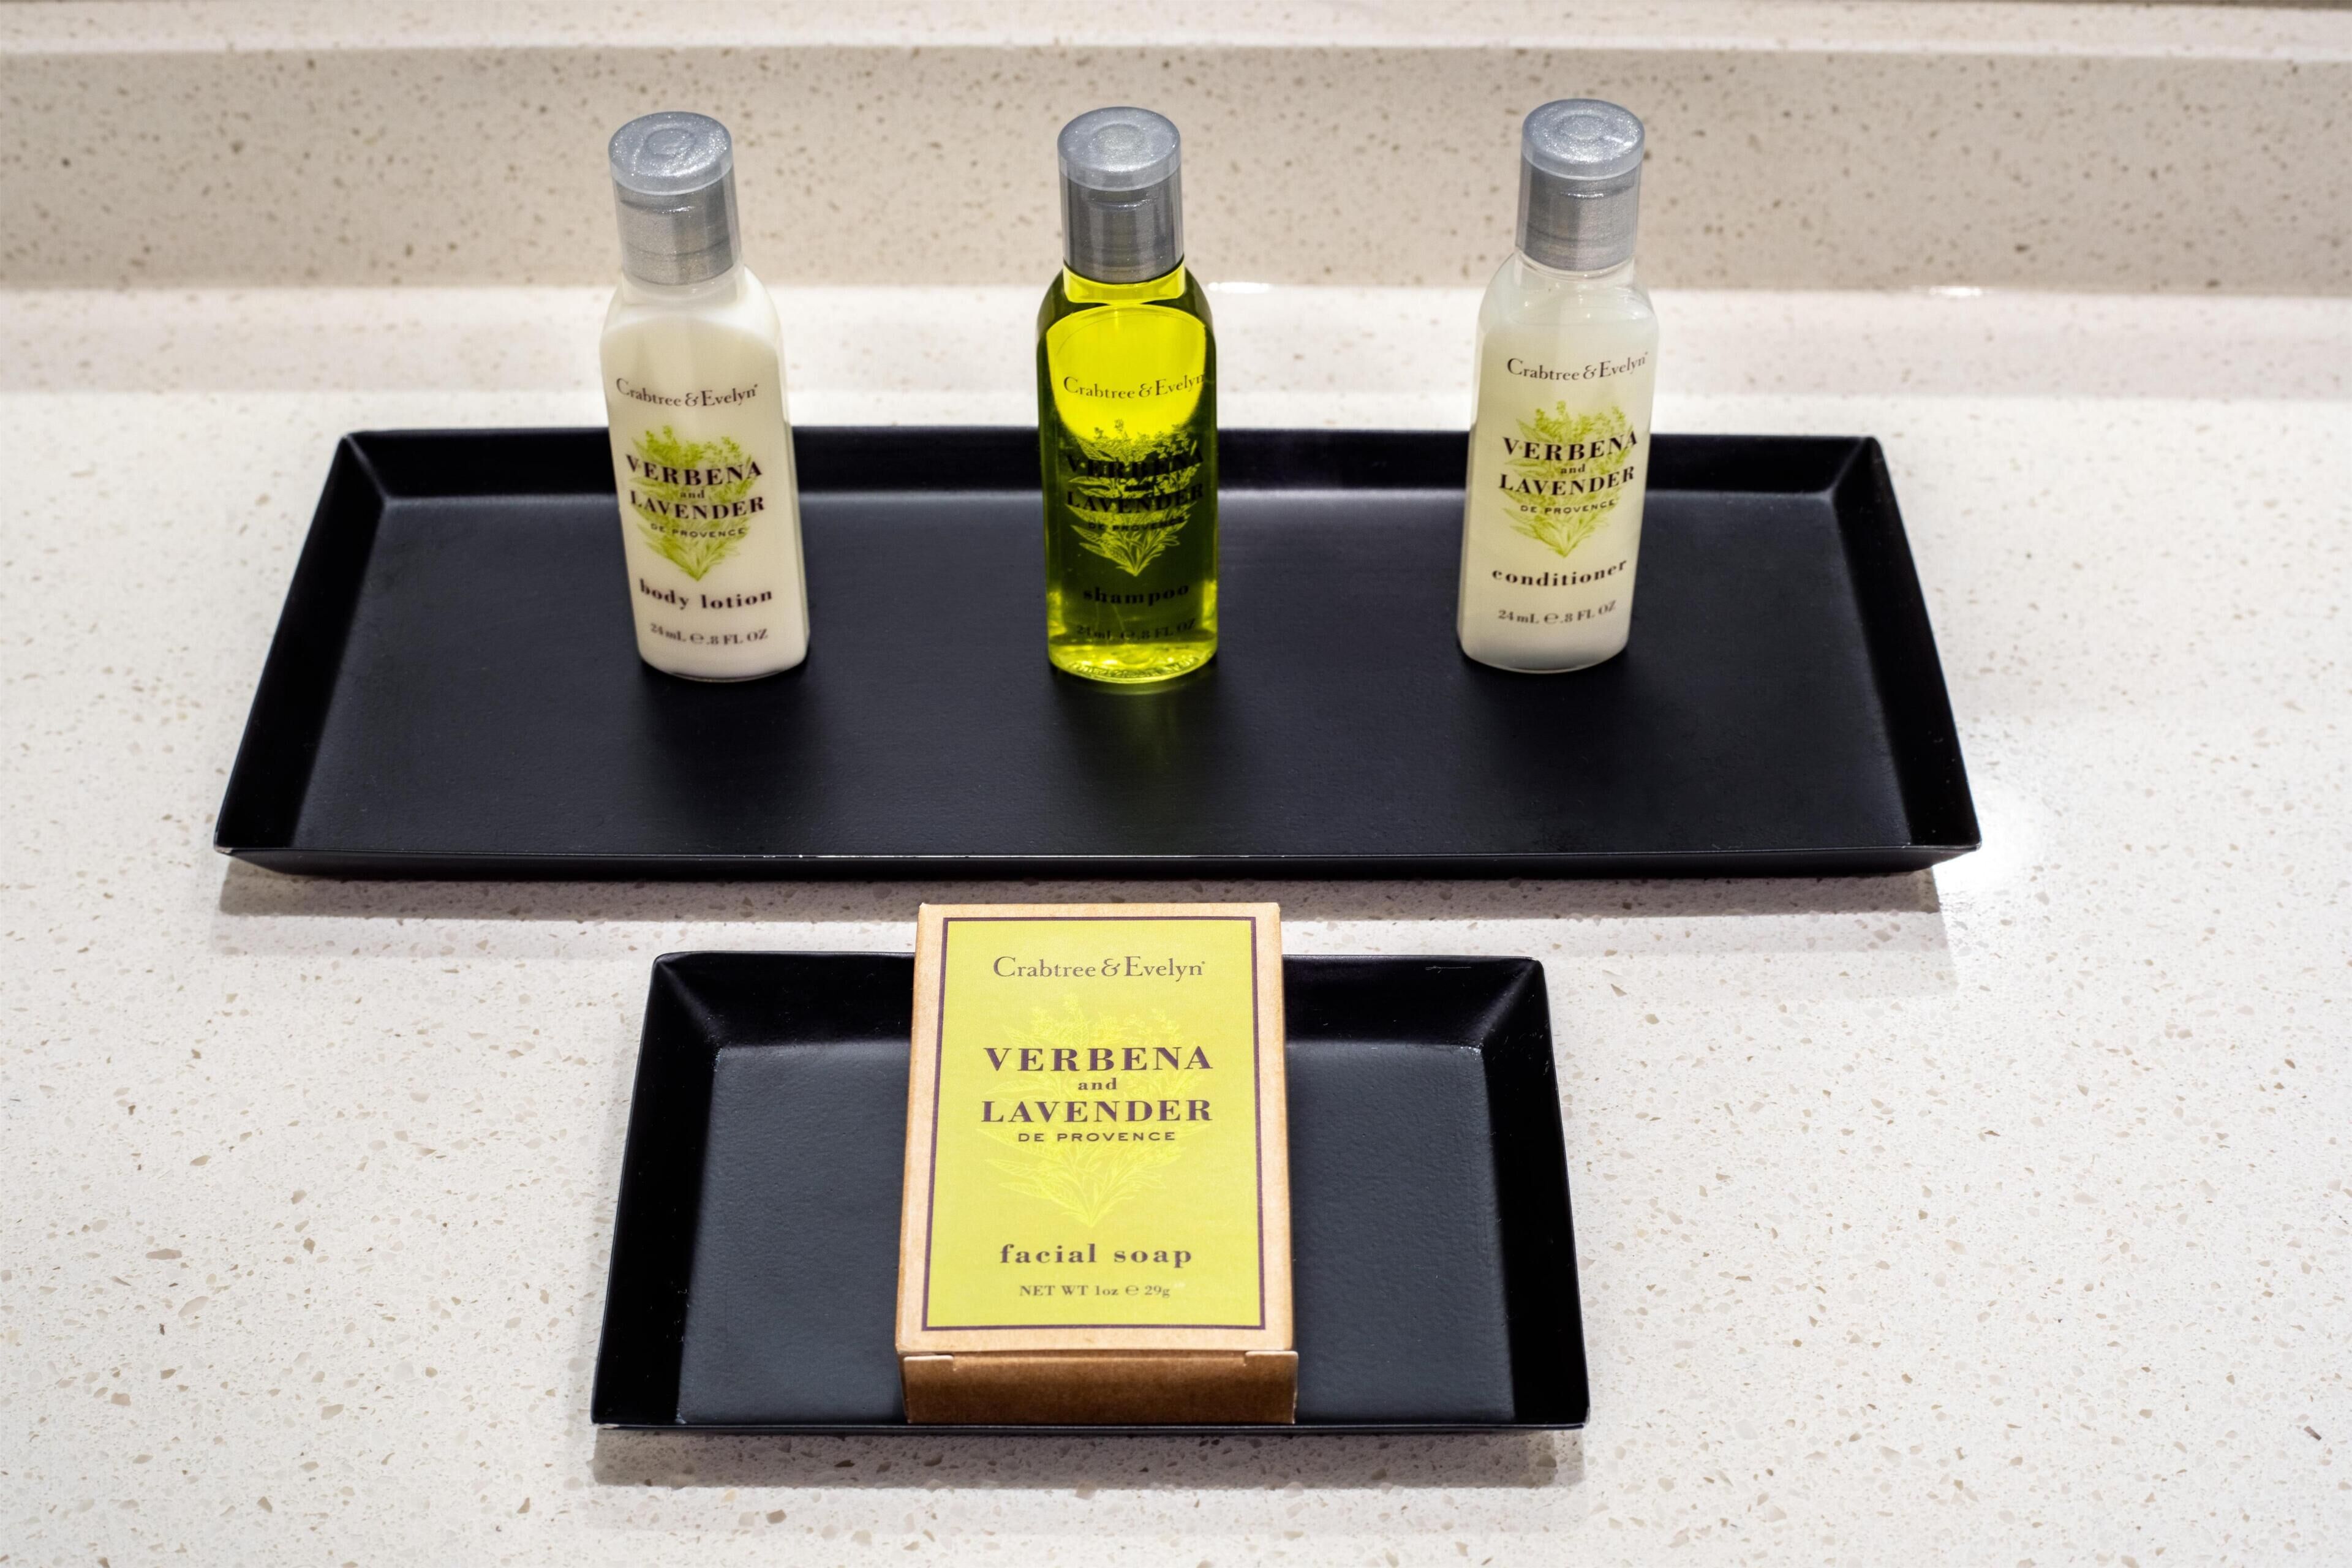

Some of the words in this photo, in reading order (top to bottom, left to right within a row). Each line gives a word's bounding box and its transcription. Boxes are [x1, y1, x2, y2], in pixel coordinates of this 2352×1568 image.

[1506, 357, 1580, 381] Crabtree
[1582, 364, 1597, 380] &
[616, 377, 682, 407] Crabtree
[685, 393, 699, 407] &
[1063, 376, 1136, 399] Crabtree
[1138, 383, 1153, 399] &
[1502, 430, 1639, 461] VERBENA
[626, 454, 763, 487] VERBENA
[1066, 447, 1204, 479] VERBENA
[1560, 463, 1586, 474] and
[1498, 466, 1636, 496] LAVENDER
[630, 491, 765, 520] LAVENDER
[680, 489, 706, 500] and
[1067, 483, 1204, 514] LAVENDER
[1520, 504, 1536, 513] DE
[1544, 499, 1616, 514] PROVENCE
[650, 522, 666, 533] DE
[672, 527, 746, 538] PROVENCE
[1112, 515, 1187, 532] PROVENCE
[1491, 559, 1628, 588] conditioner
[640, 579, 690, 610] body
[701, 589, 773, 610] lotion
[1083, 584, 1190, 608] shampoo
[747, 628, 769, 643] OZ
[993, 956, 1096, 979] Crabtree
[1101, 958, 1122, 978] &
[983, 1046, 1214, 1072] VERBENA
[1077, 1077, 1118, 1092] and
[981, 1099, 1213, 1124] LAVENDER
[1017, 1132, 1045, 1143] DE
[1057, 1131, 1177, 1143] PROVENCE
[1000, 1243, 1097, 1265] facial
[1114, 1248, 1193, 1269] soap
[1019, 1284, 1055, 1297] NET
[1060, 1284, 1090, 1297] WT
[1144, 1284, 1170, 1299] 29g
